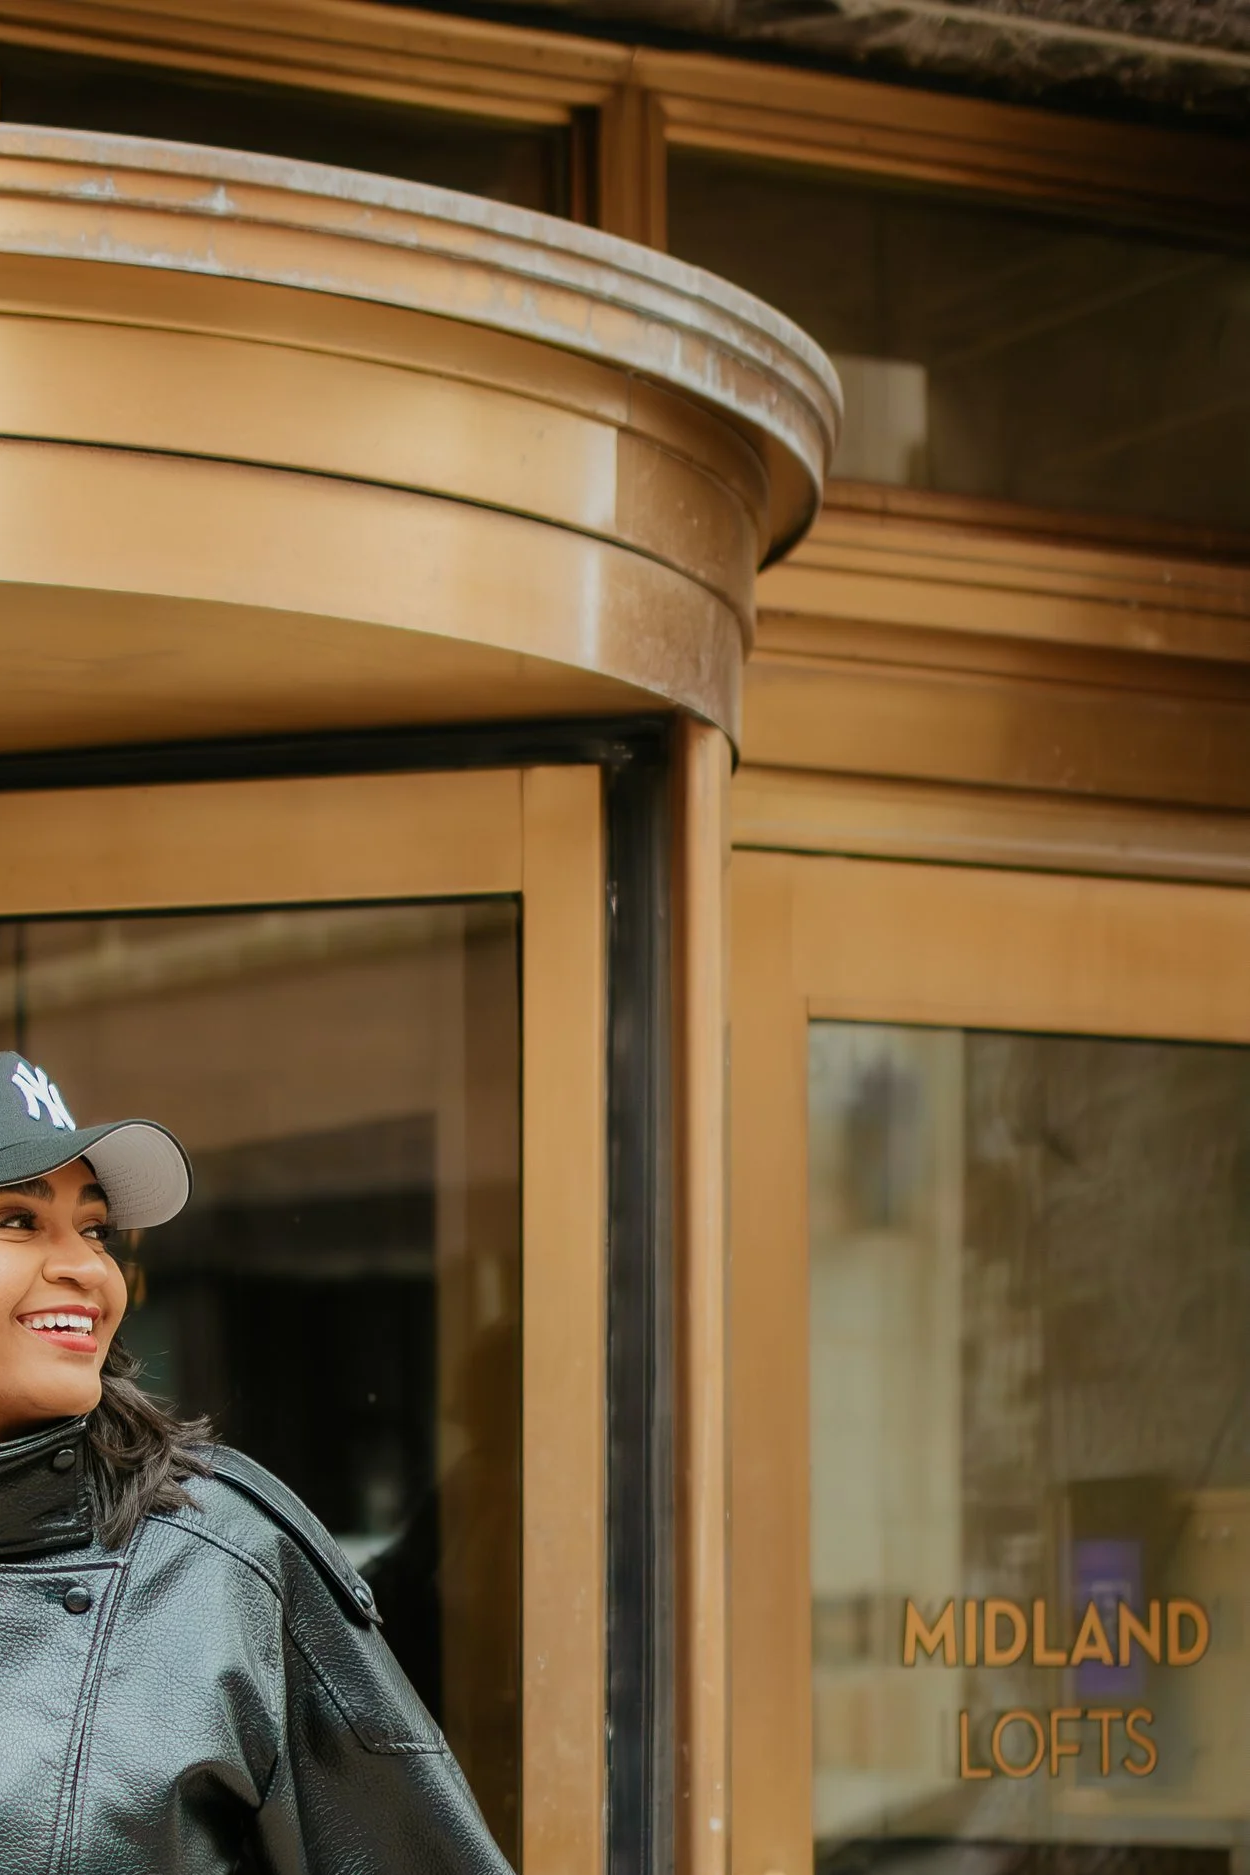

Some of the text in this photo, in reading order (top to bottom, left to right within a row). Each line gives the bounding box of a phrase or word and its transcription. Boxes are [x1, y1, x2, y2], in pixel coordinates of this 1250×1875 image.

[10, 1060, 76, 1132] NY
[902, 1597, 1211, 1668] MIDLAND
[958, 1707, 1159, 1780] LOFTS
